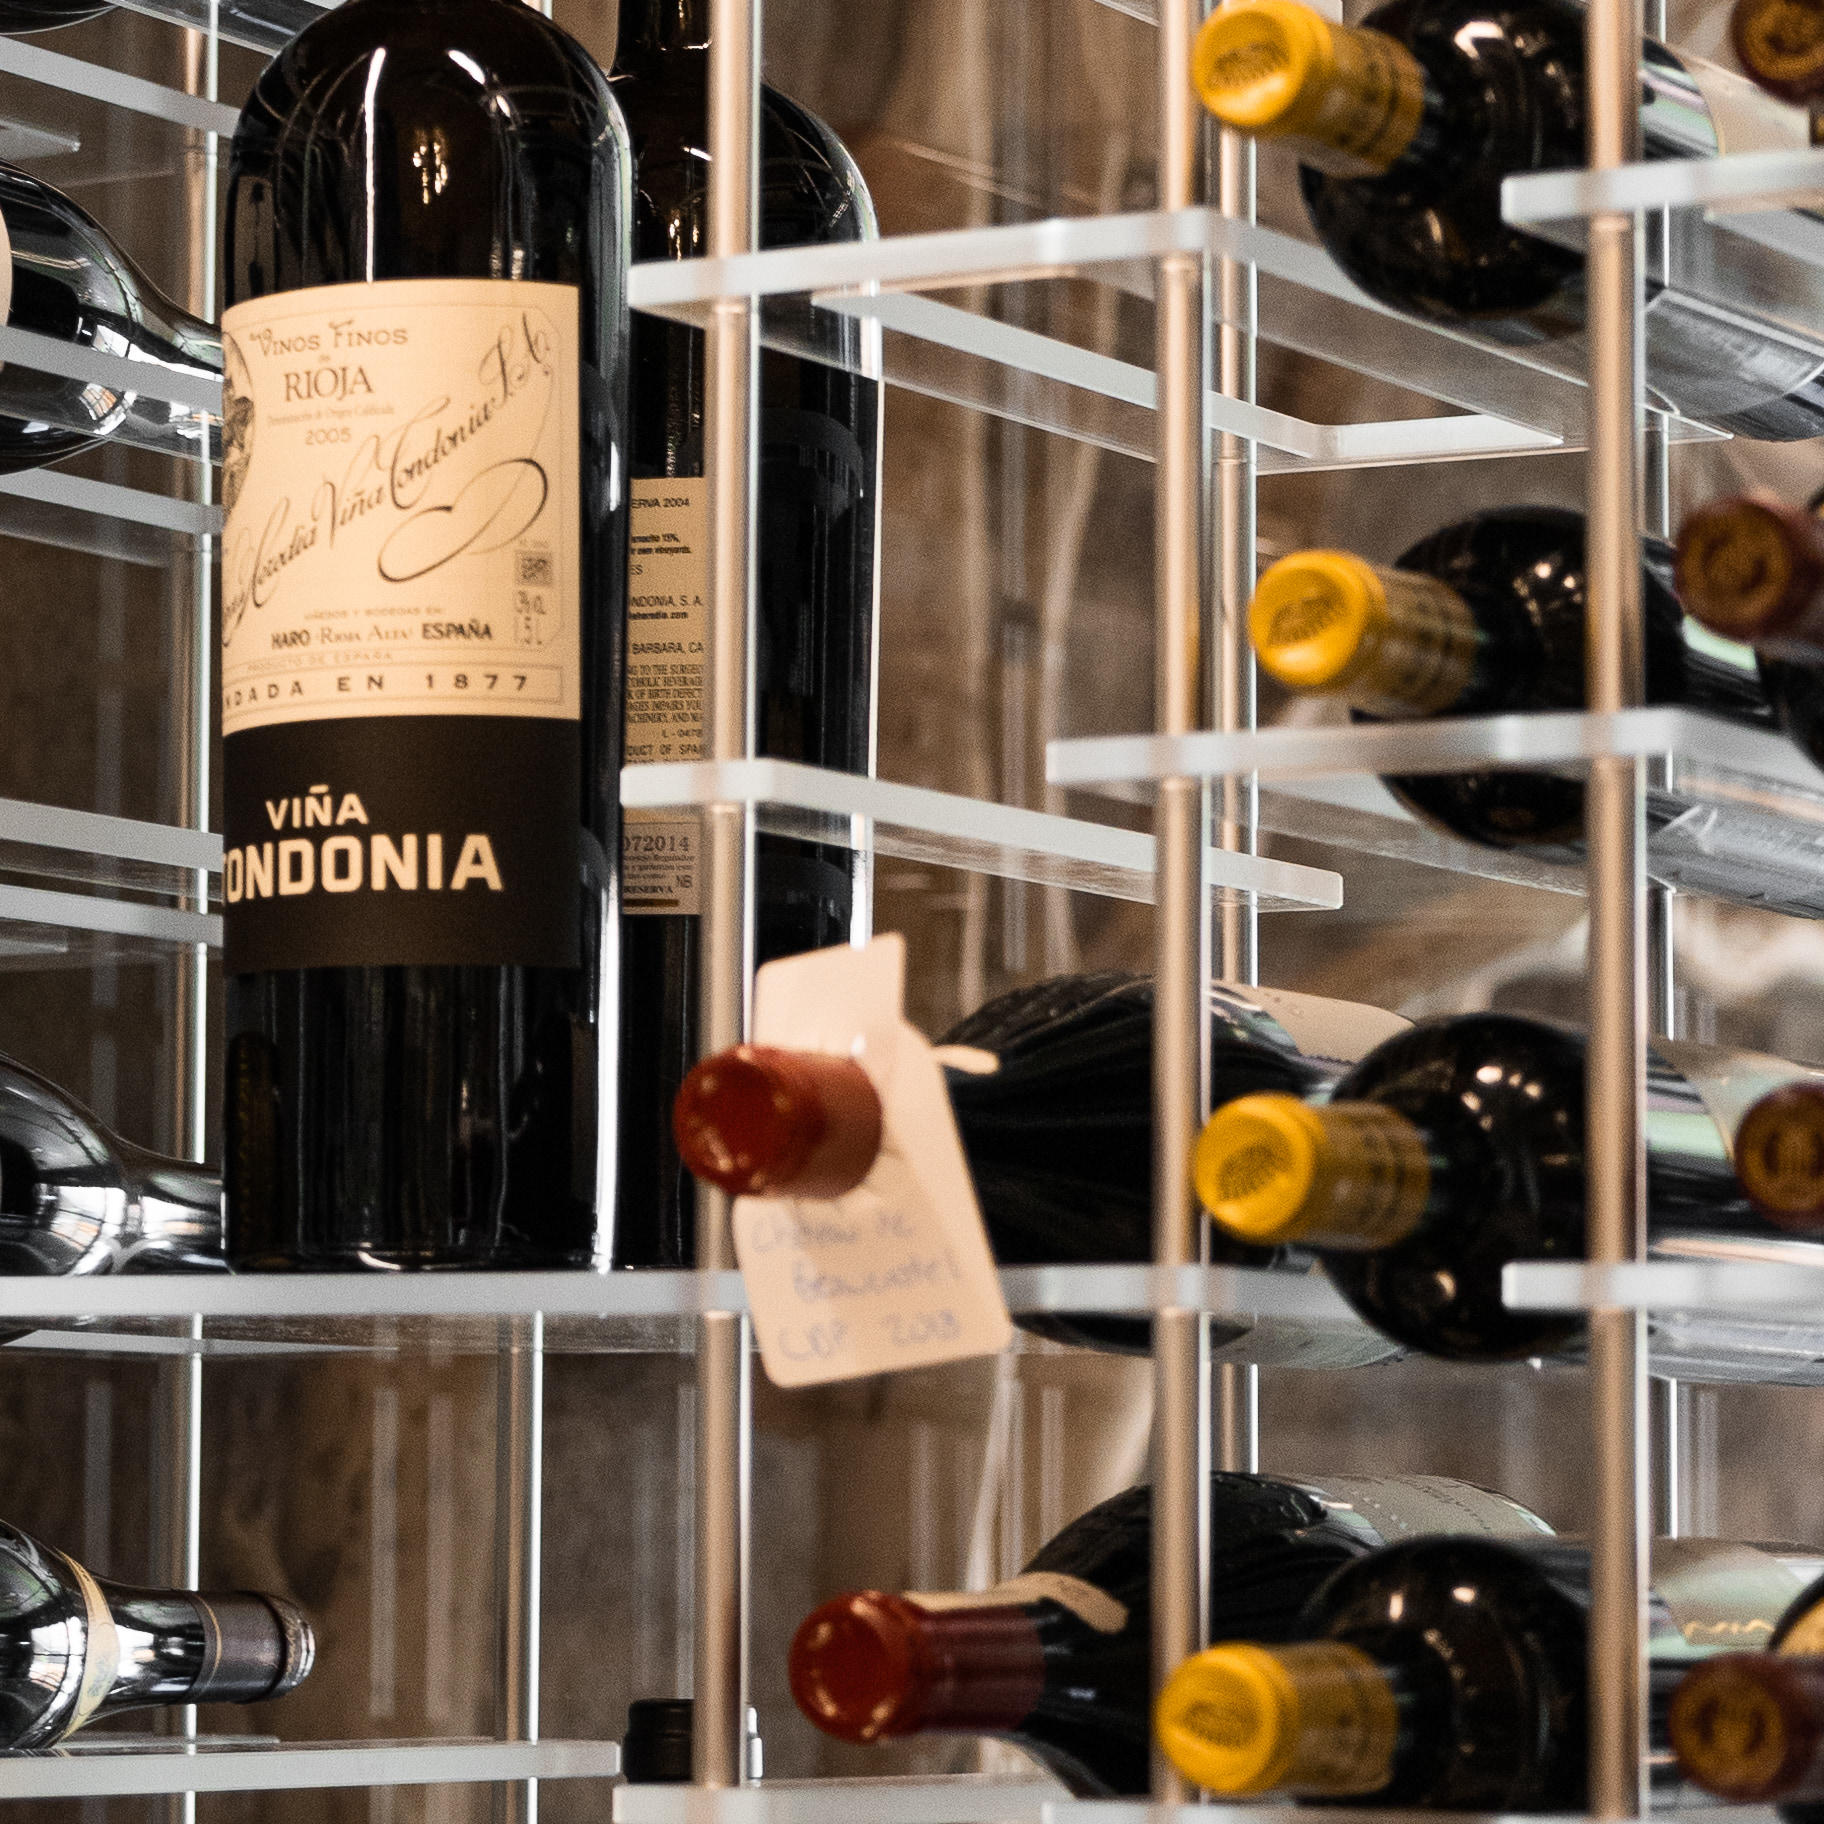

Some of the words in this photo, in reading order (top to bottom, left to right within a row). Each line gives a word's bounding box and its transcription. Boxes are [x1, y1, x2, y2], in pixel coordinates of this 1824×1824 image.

[284, 366, 373, 402] RIOJA
[305, 428, 352, 445] 2005
[272, 629, 311, 650] HARO
[422, 619, 492, 641] ESPAÑA
[337, 674, 385, 692] EN
[426, 674, 528, 692] 1877
[266, 784, 369, 830] VIÑA
[223, 833, 503, 904] ONDONIA
